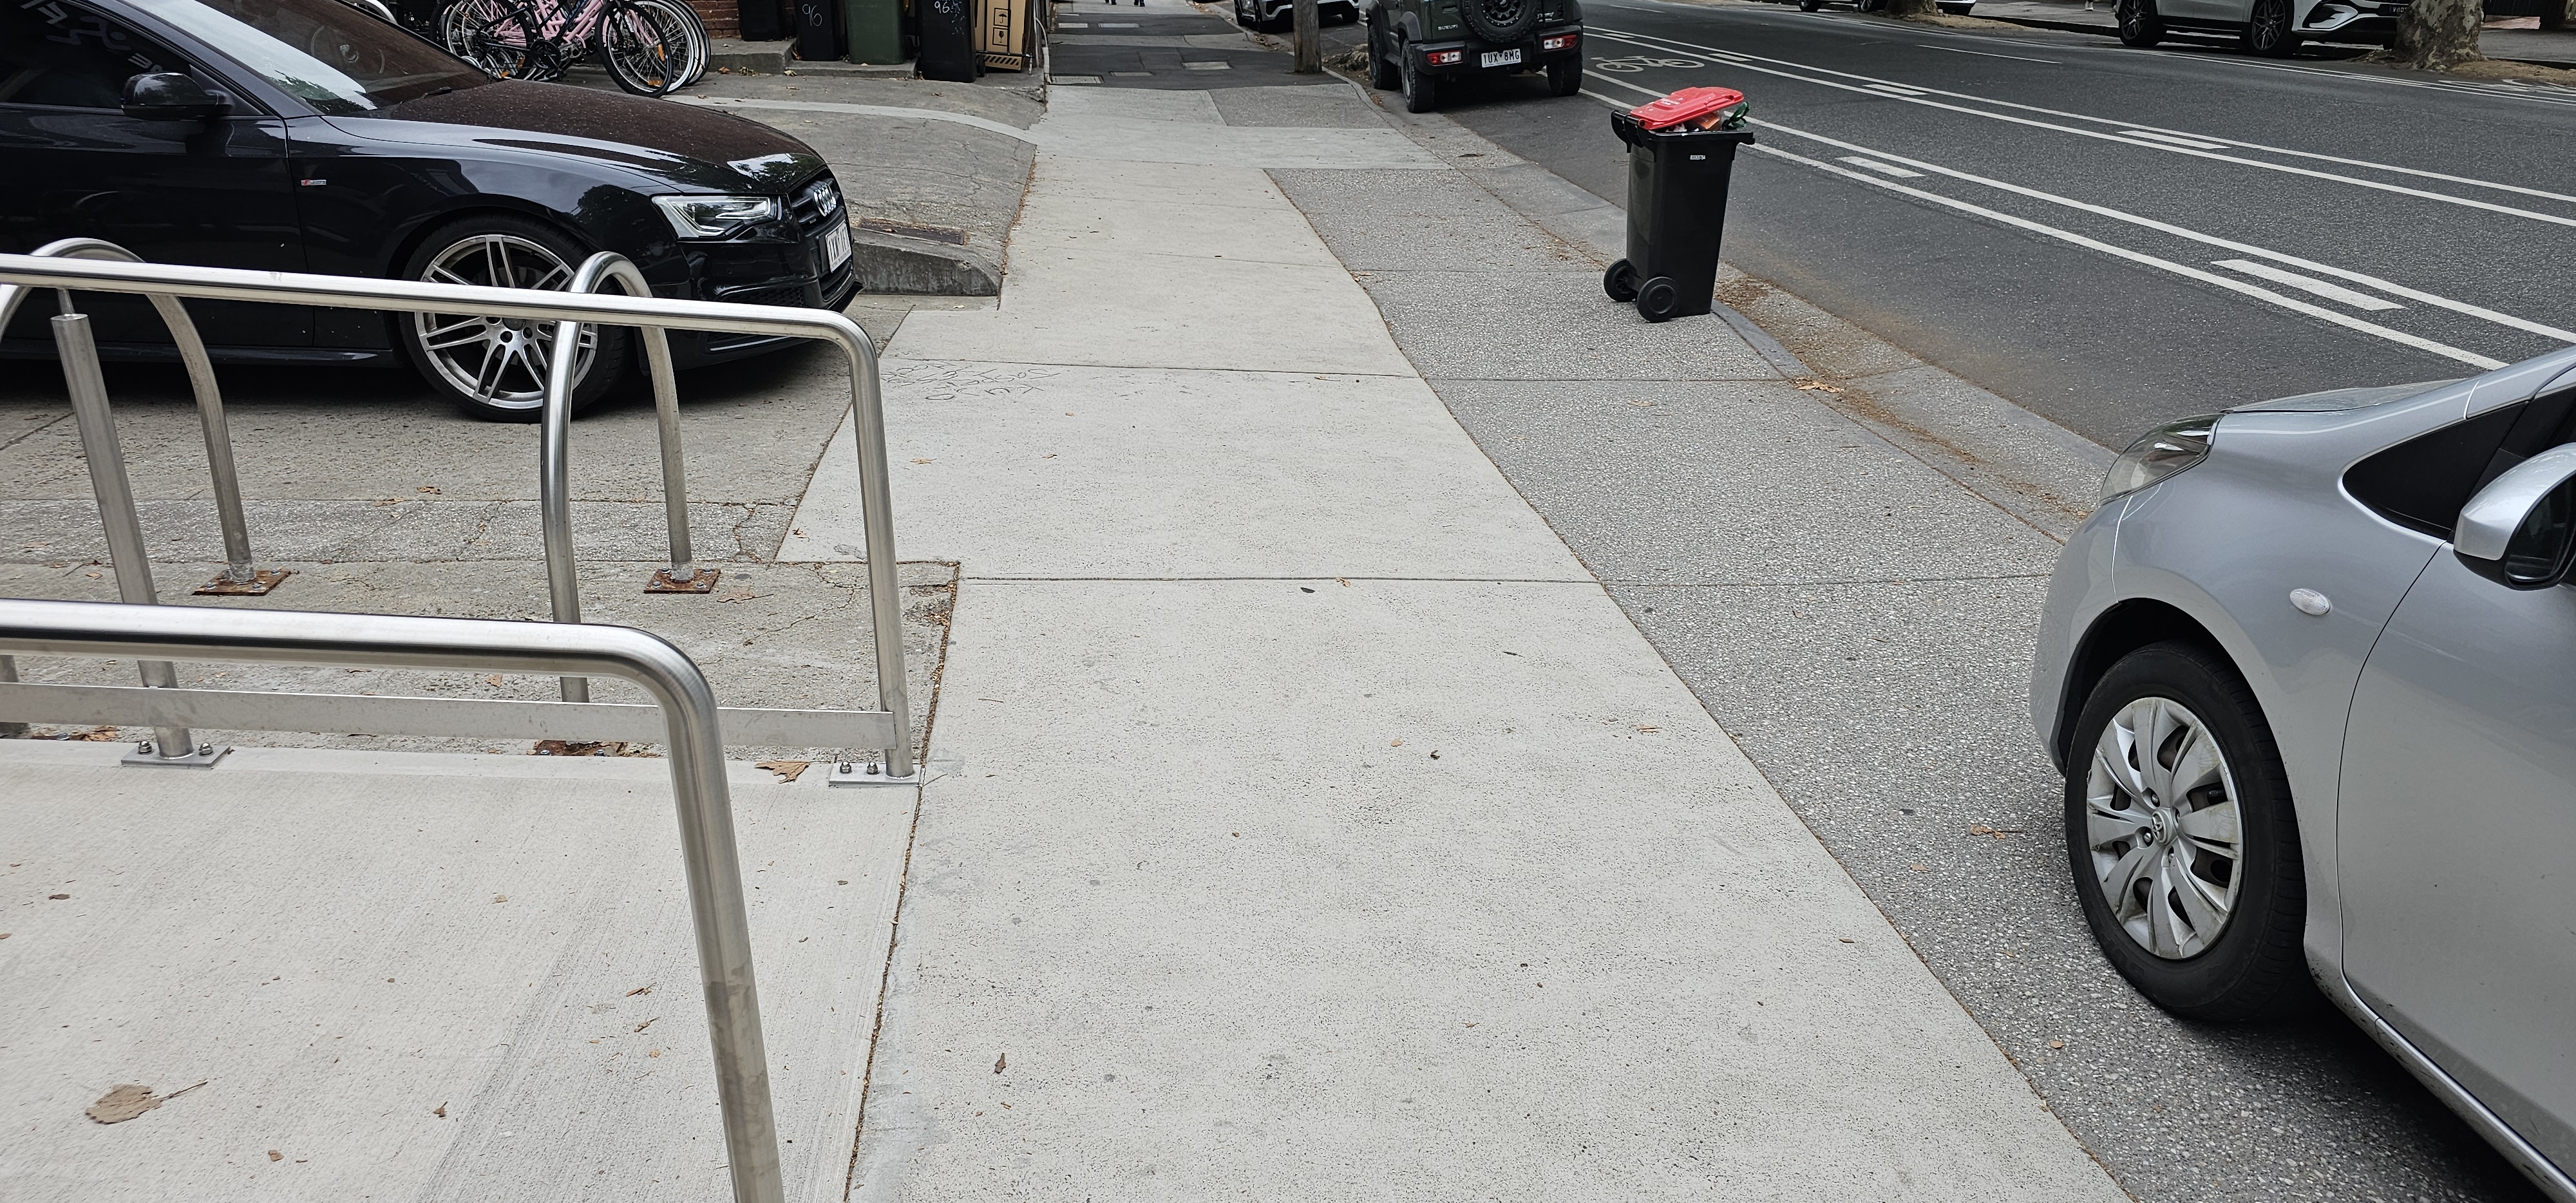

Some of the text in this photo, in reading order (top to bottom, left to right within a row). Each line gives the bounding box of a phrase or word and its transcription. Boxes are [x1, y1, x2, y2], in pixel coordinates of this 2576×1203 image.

[802, 3, 822, 26] 96
[934, 1, 950, 14] 96
[1483, 53, 1499, 64] 1UX
[1504, 50, 1519, 61] 8MG
